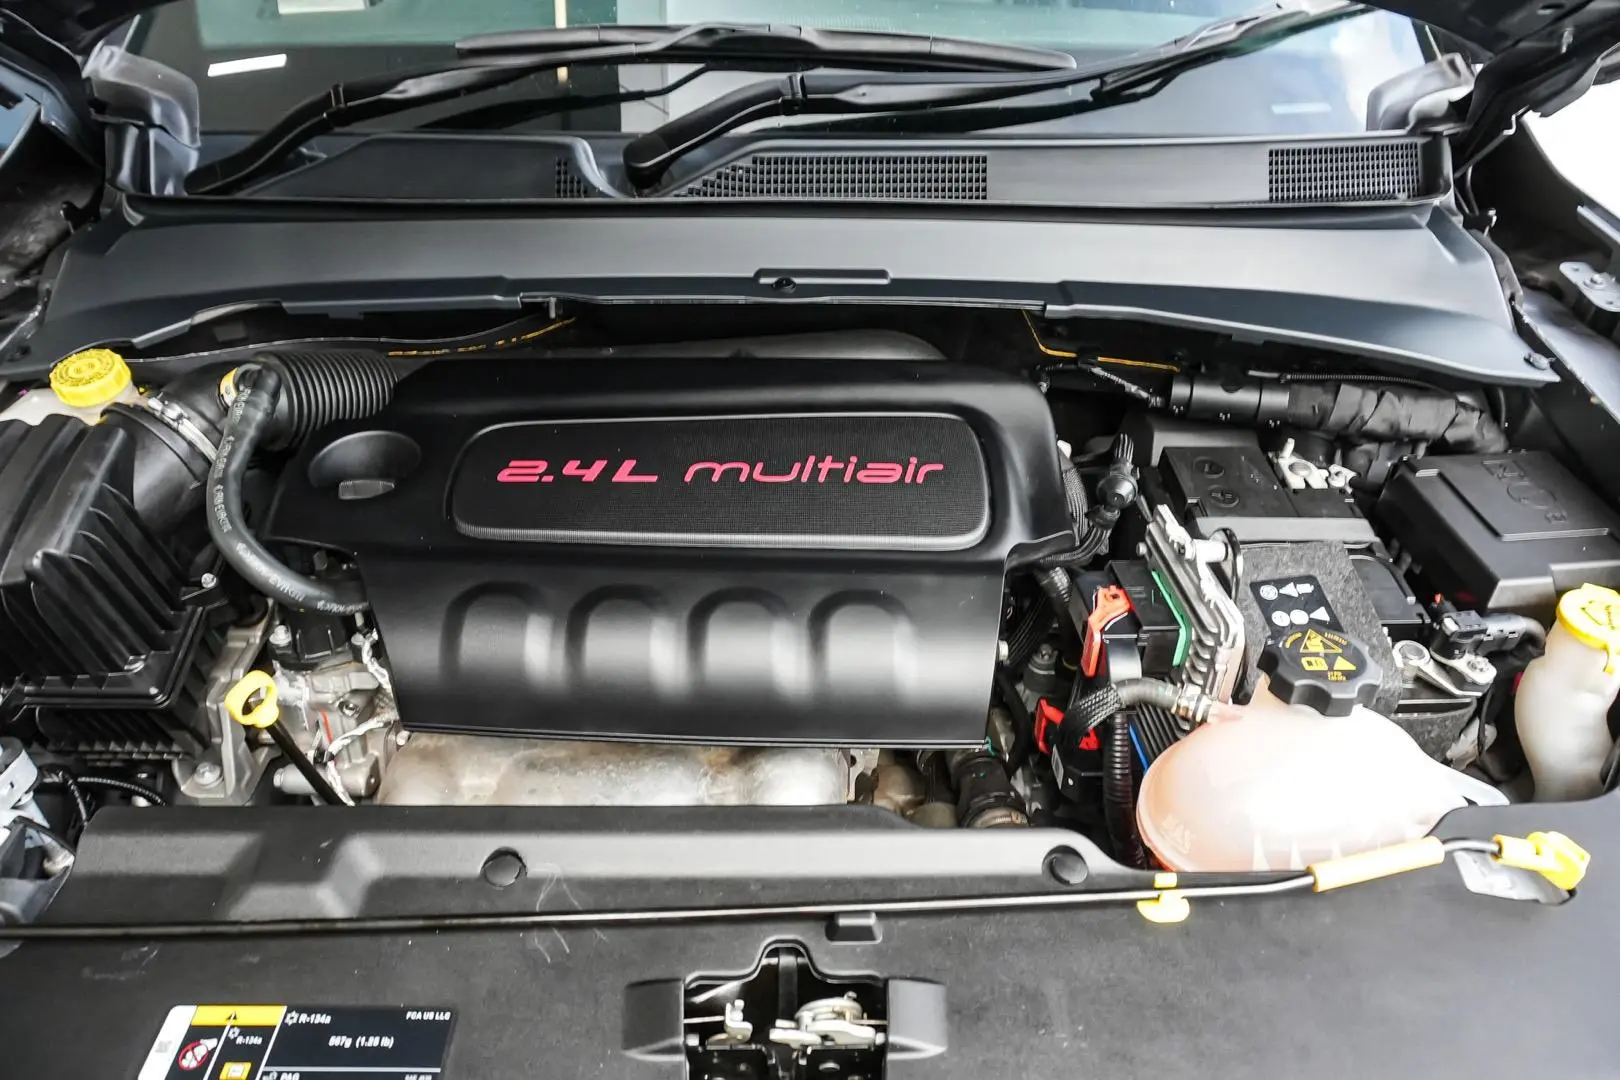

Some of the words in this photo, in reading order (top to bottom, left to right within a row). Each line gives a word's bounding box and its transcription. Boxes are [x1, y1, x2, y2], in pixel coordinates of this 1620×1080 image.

[683, 455, 944, 484] multiair
[405, 1011, 422, 1021] FCA
[423, 1011, 434, 1021] US
[434, 1011, 451, 1021] LLC
